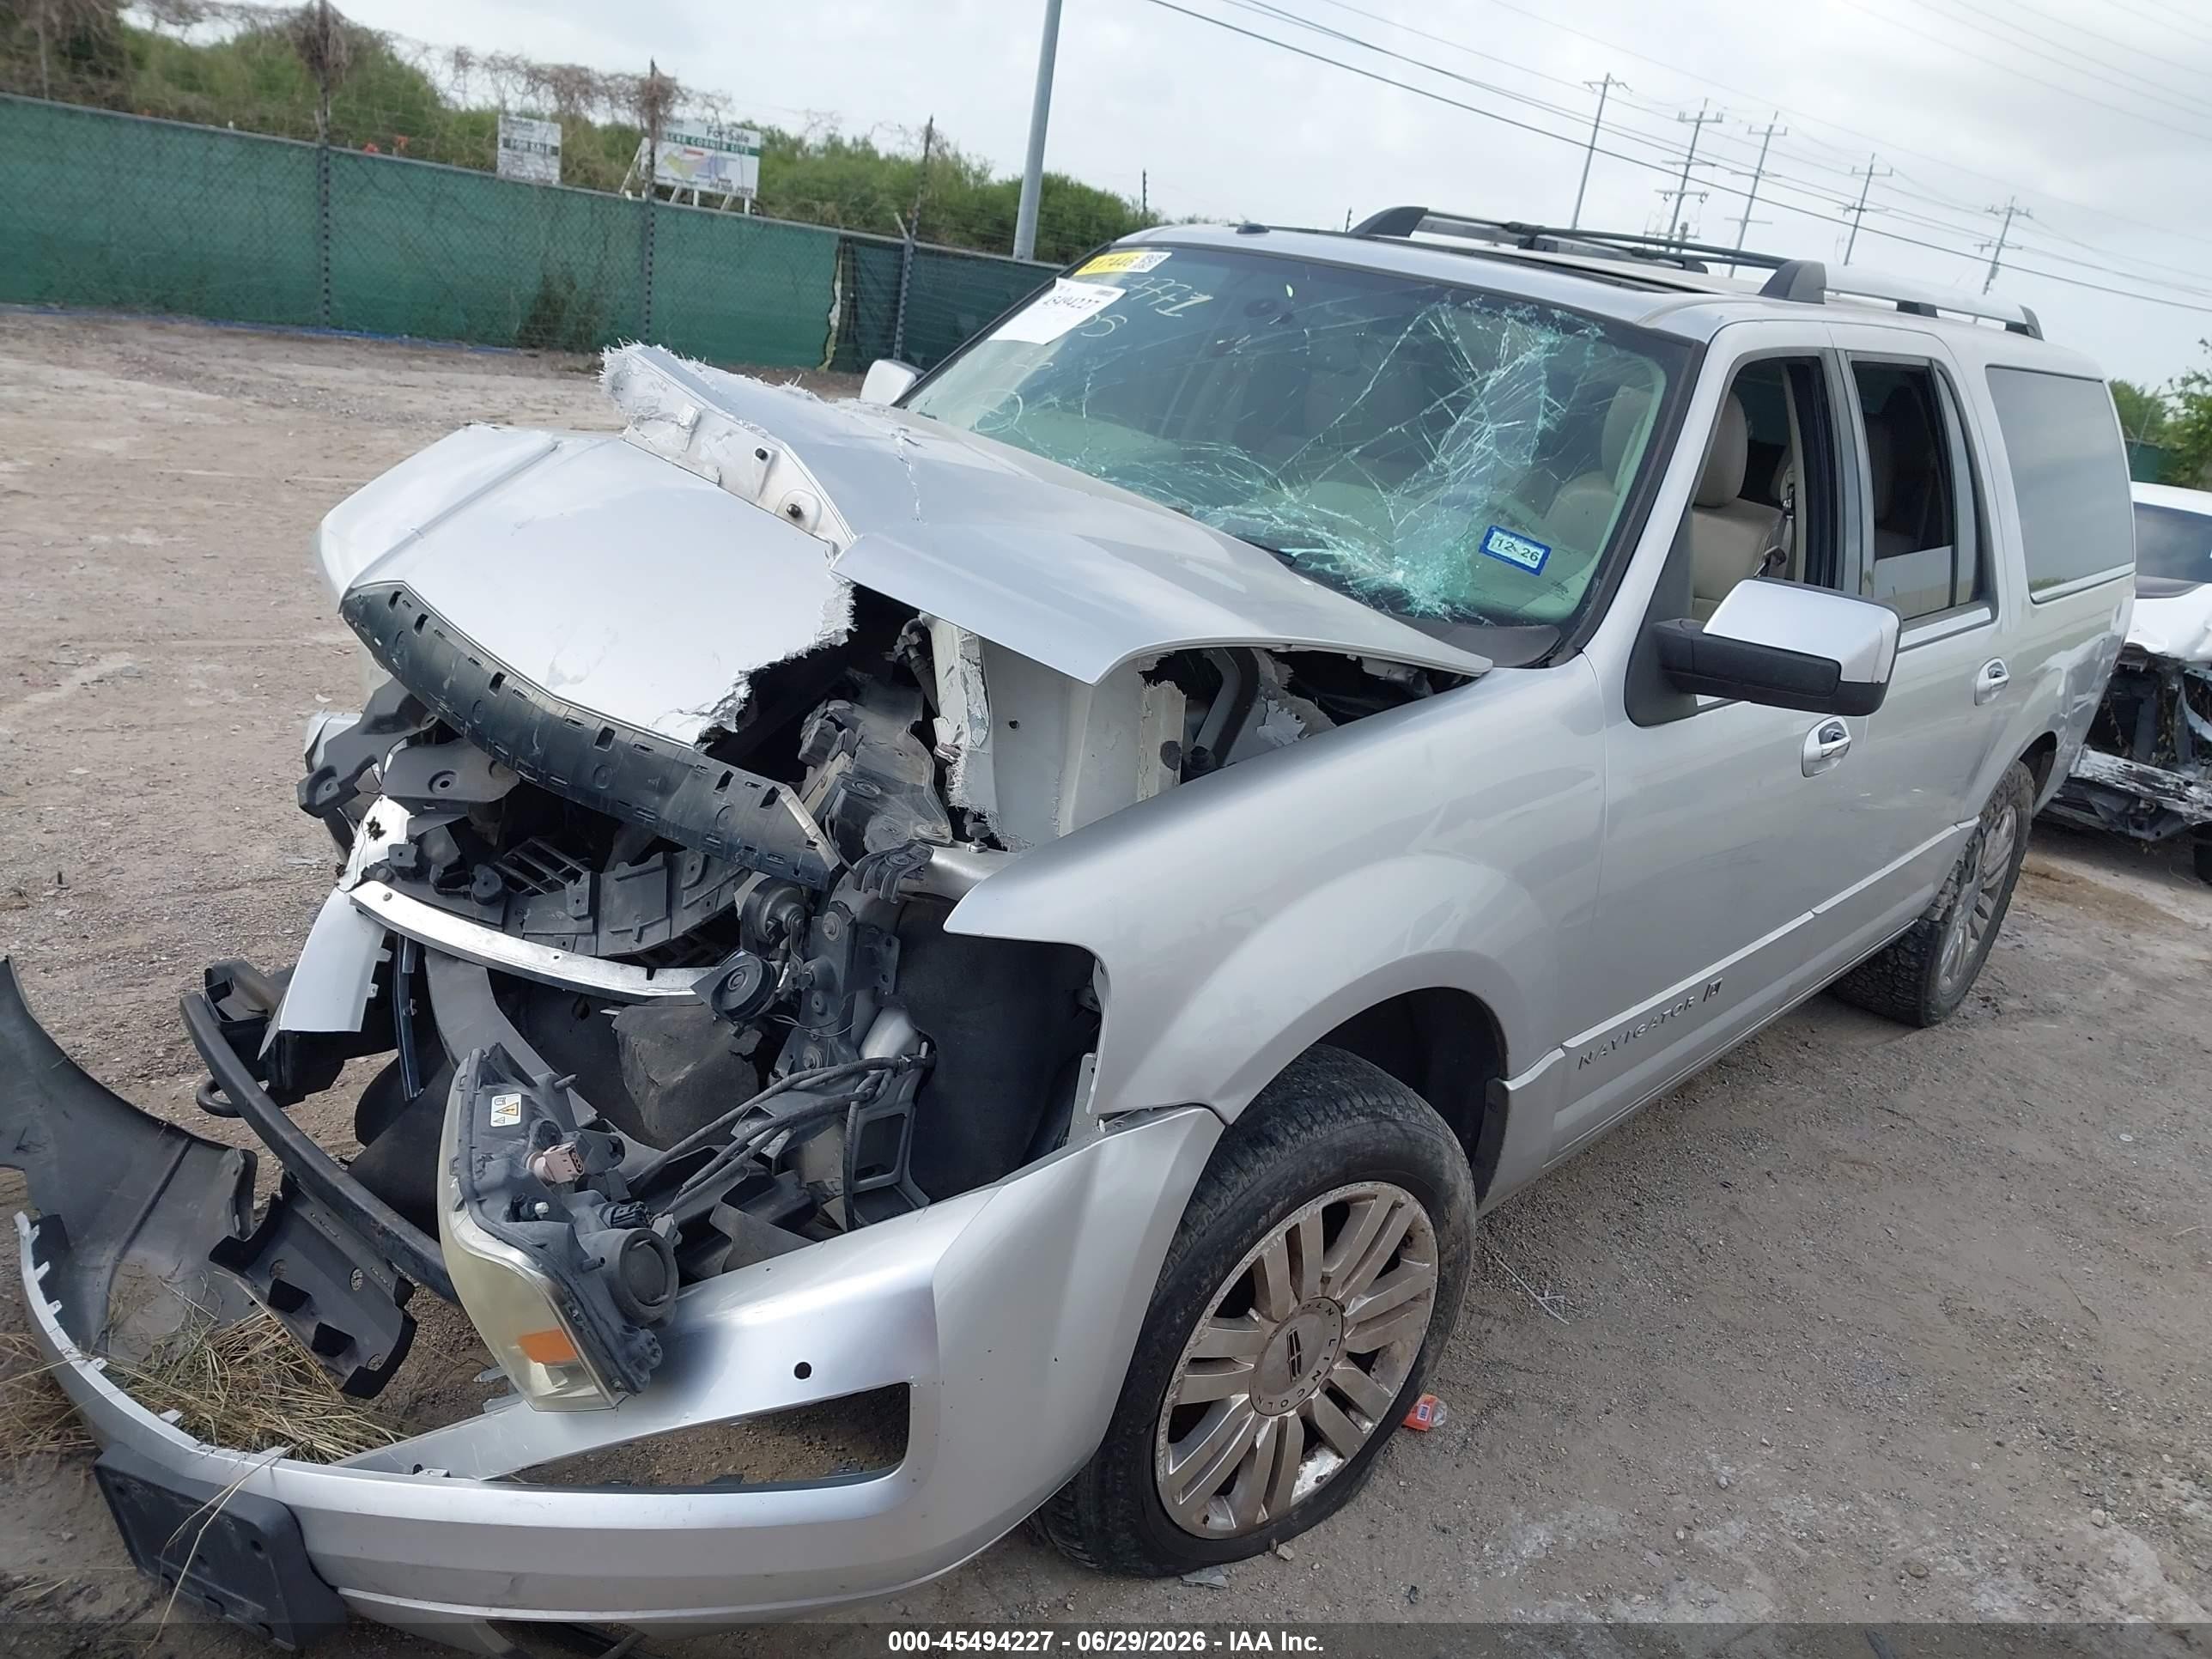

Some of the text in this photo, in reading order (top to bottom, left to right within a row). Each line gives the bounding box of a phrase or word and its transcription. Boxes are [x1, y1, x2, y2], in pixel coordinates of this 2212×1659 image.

[707, 125, 750, 144] For Sale
[1497, 538, 1540, 562] 12 26
[1578, 996, 1695, 1070] NAVIGATOR
